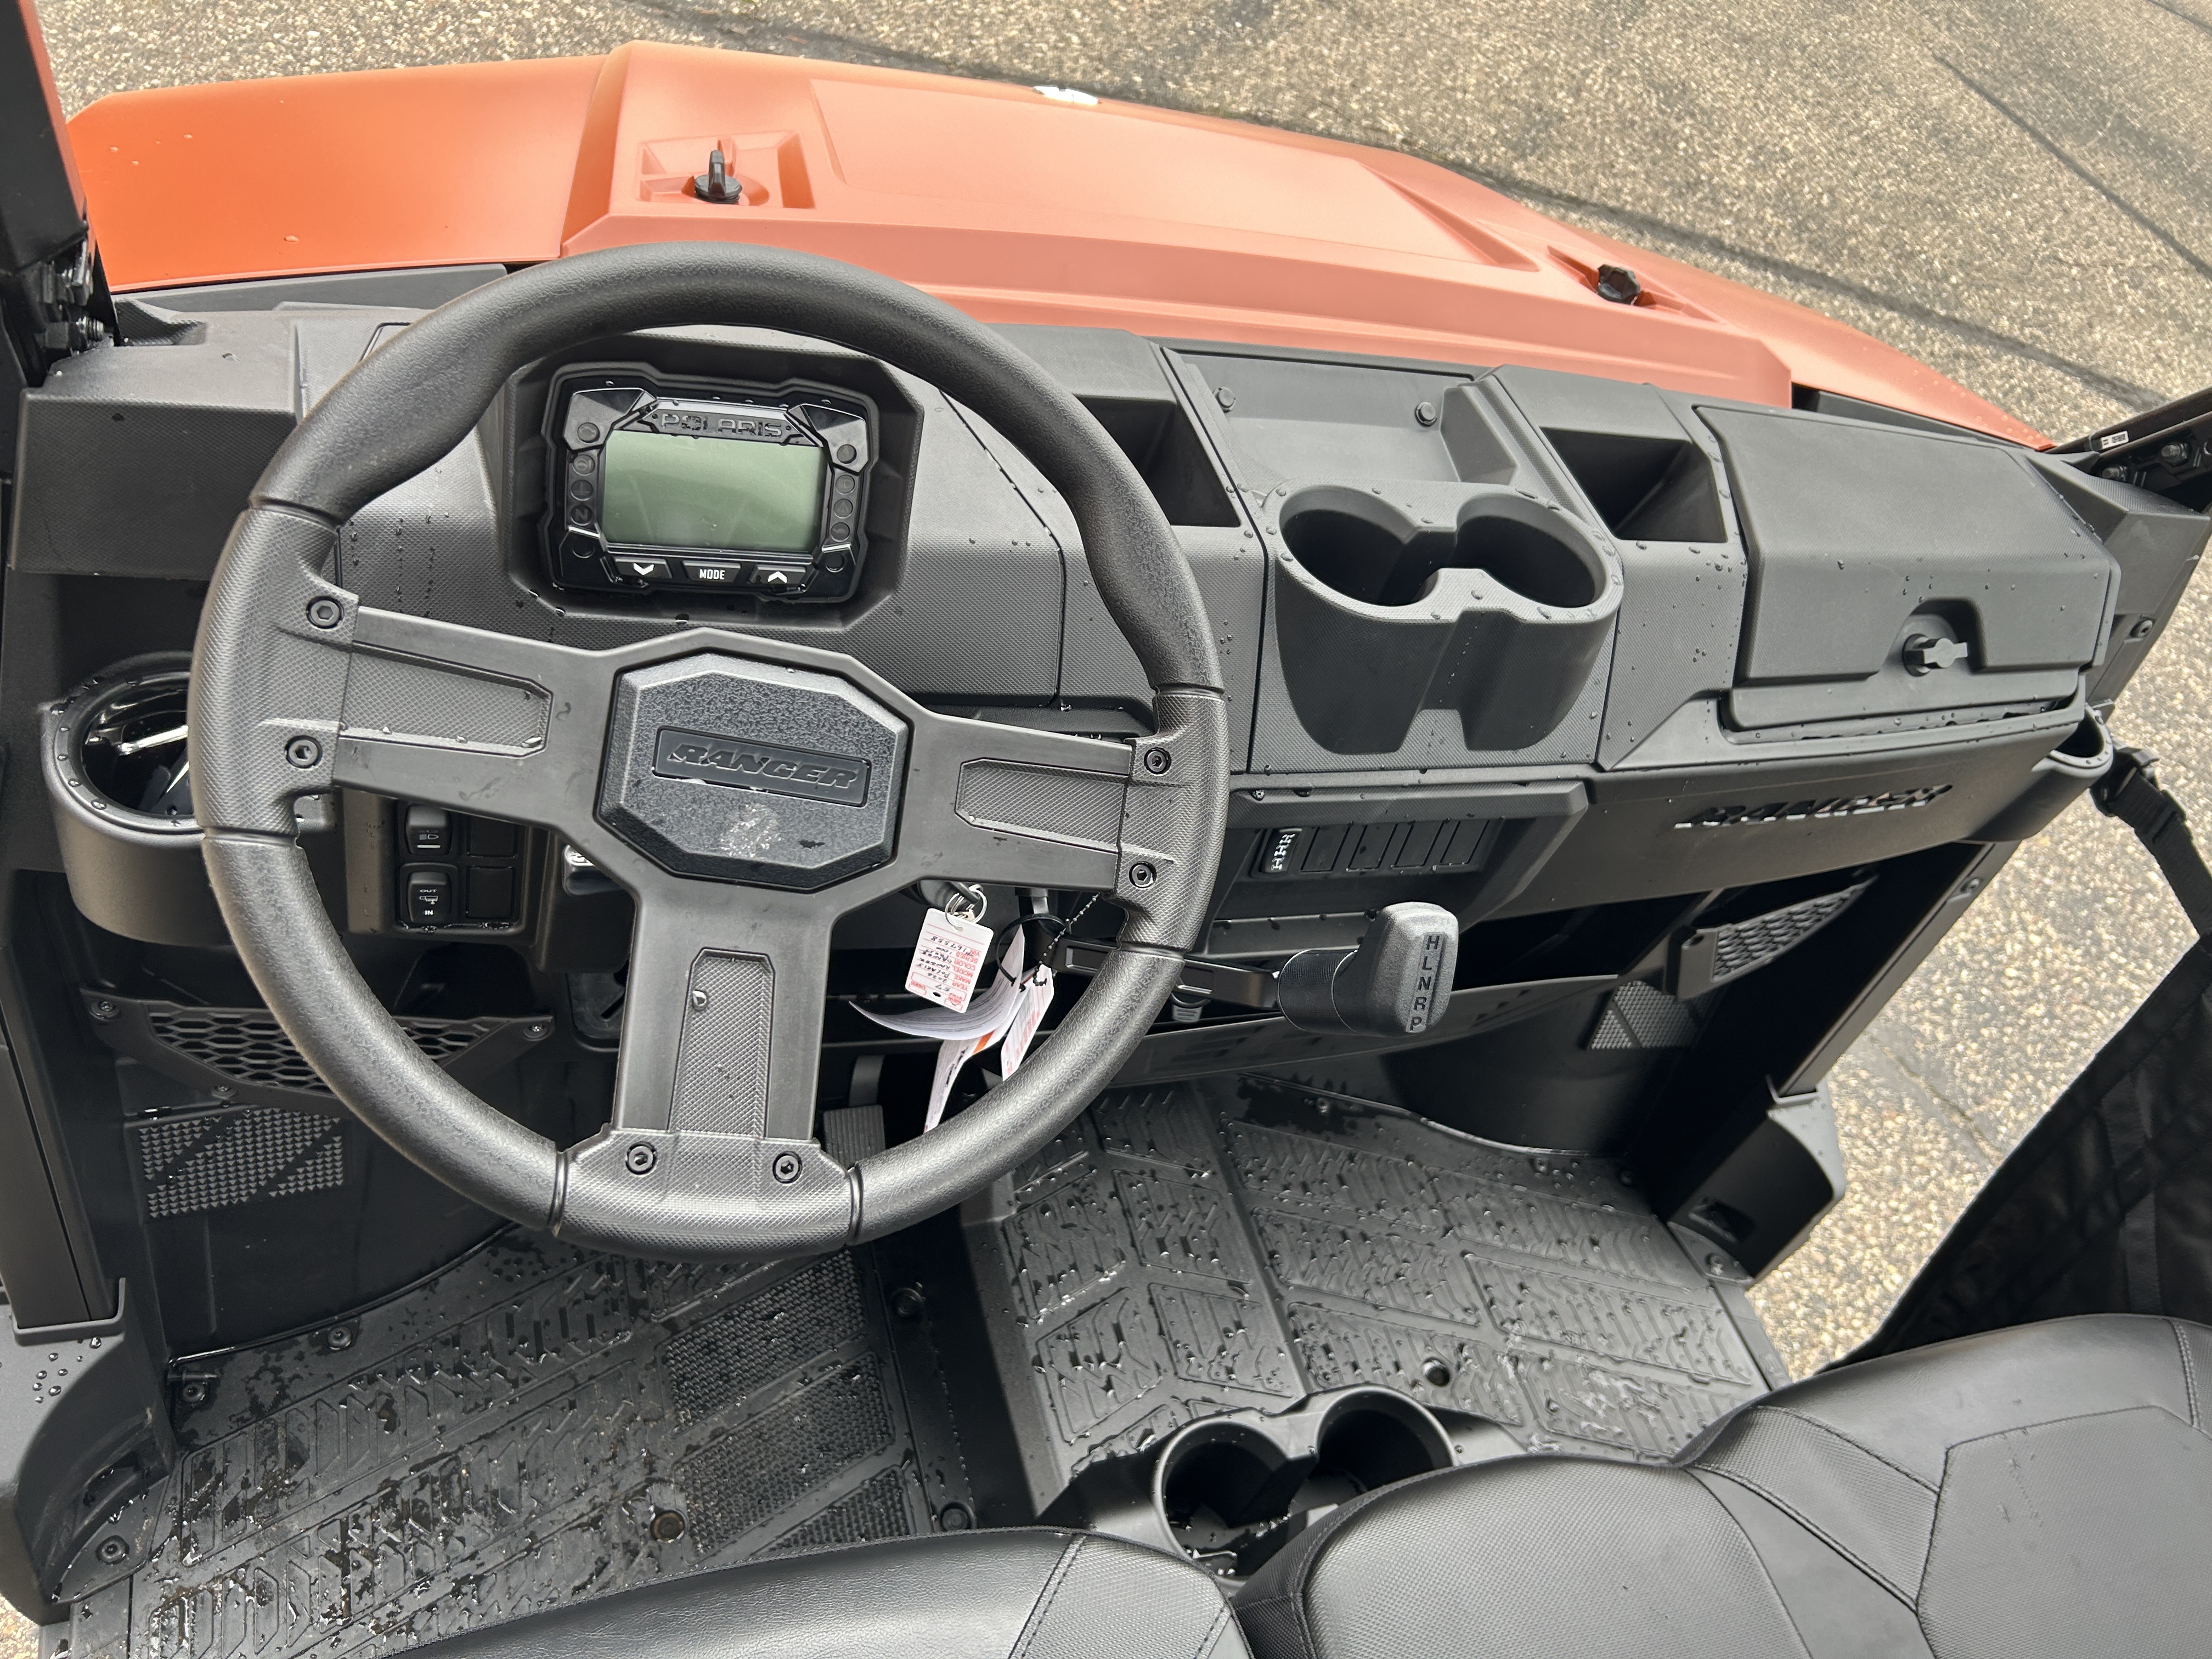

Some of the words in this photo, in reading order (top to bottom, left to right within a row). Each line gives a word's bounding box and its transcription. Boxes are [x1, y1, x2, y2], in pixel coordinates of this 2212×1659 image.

[699, 568, 725, 580] MODE
[667, 743, 859, 789] RANGER
[1427, 935, 1440, 950] H
[956, 951, 978, 964] SERIES
[970, 949, 980, 957] VIN
[954, 958, 976, 971] COLOR
[1422, 956, 1432, 971] L
[953, 965, 973, 978] MODEL
[953, 974, 971, 984] MAKE
[1418, 976, 1431, 990] N
[952, 981, 968, 991] YEAR
[1414, 996, 1427, 1011] R
[1409, 1016, 1423, 1031] P
